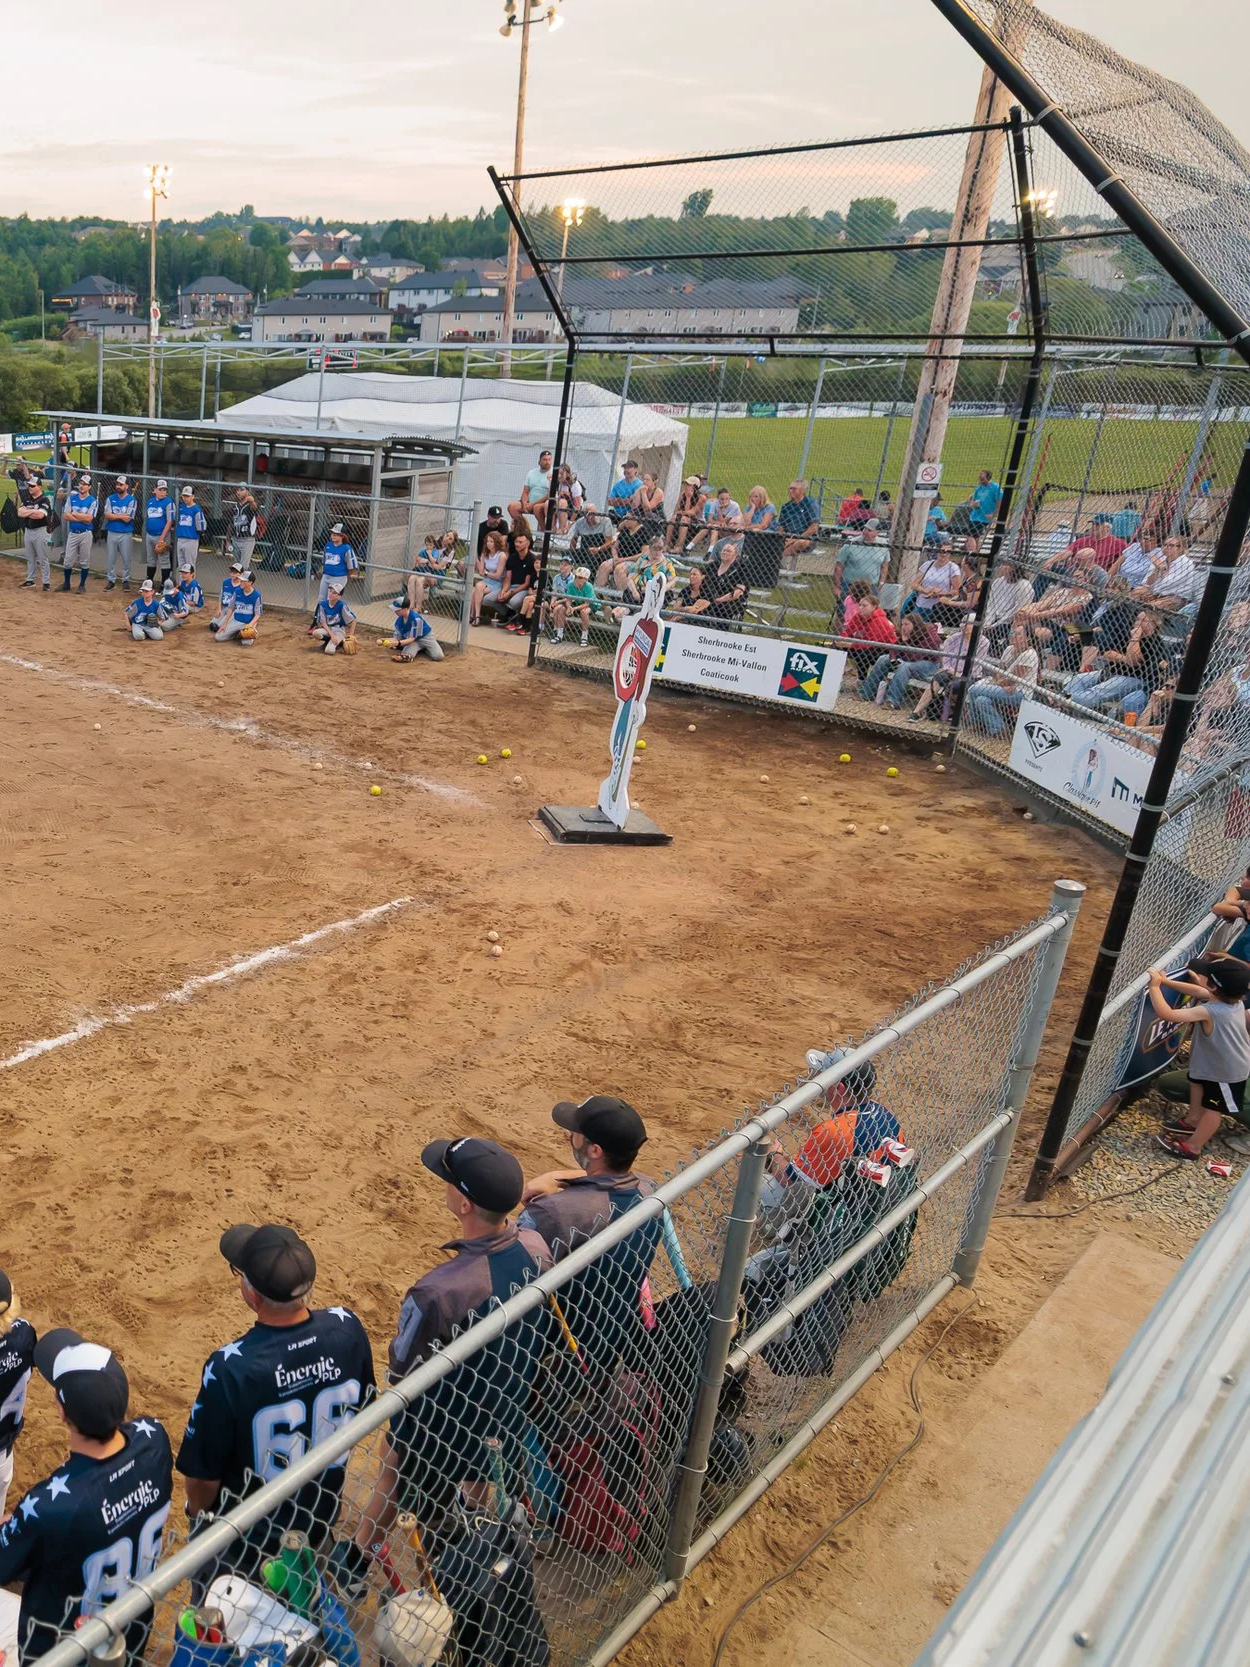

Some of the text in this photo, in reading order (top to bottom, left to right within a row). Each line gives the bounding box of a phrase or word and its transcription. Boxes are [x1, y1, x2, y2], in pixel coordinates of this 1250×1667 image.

[698, 635, 757, 654] Sherbrooke Est
[681, 648, 767, 672] Sherbrooke Mi-Vallon
[700, 668, 739, 683] Coaticook
[9, 1358, 23, 1371] PLP
[322, 1368, 342, 1382] PLP
[143, 1487, 160, 1508] PLP
